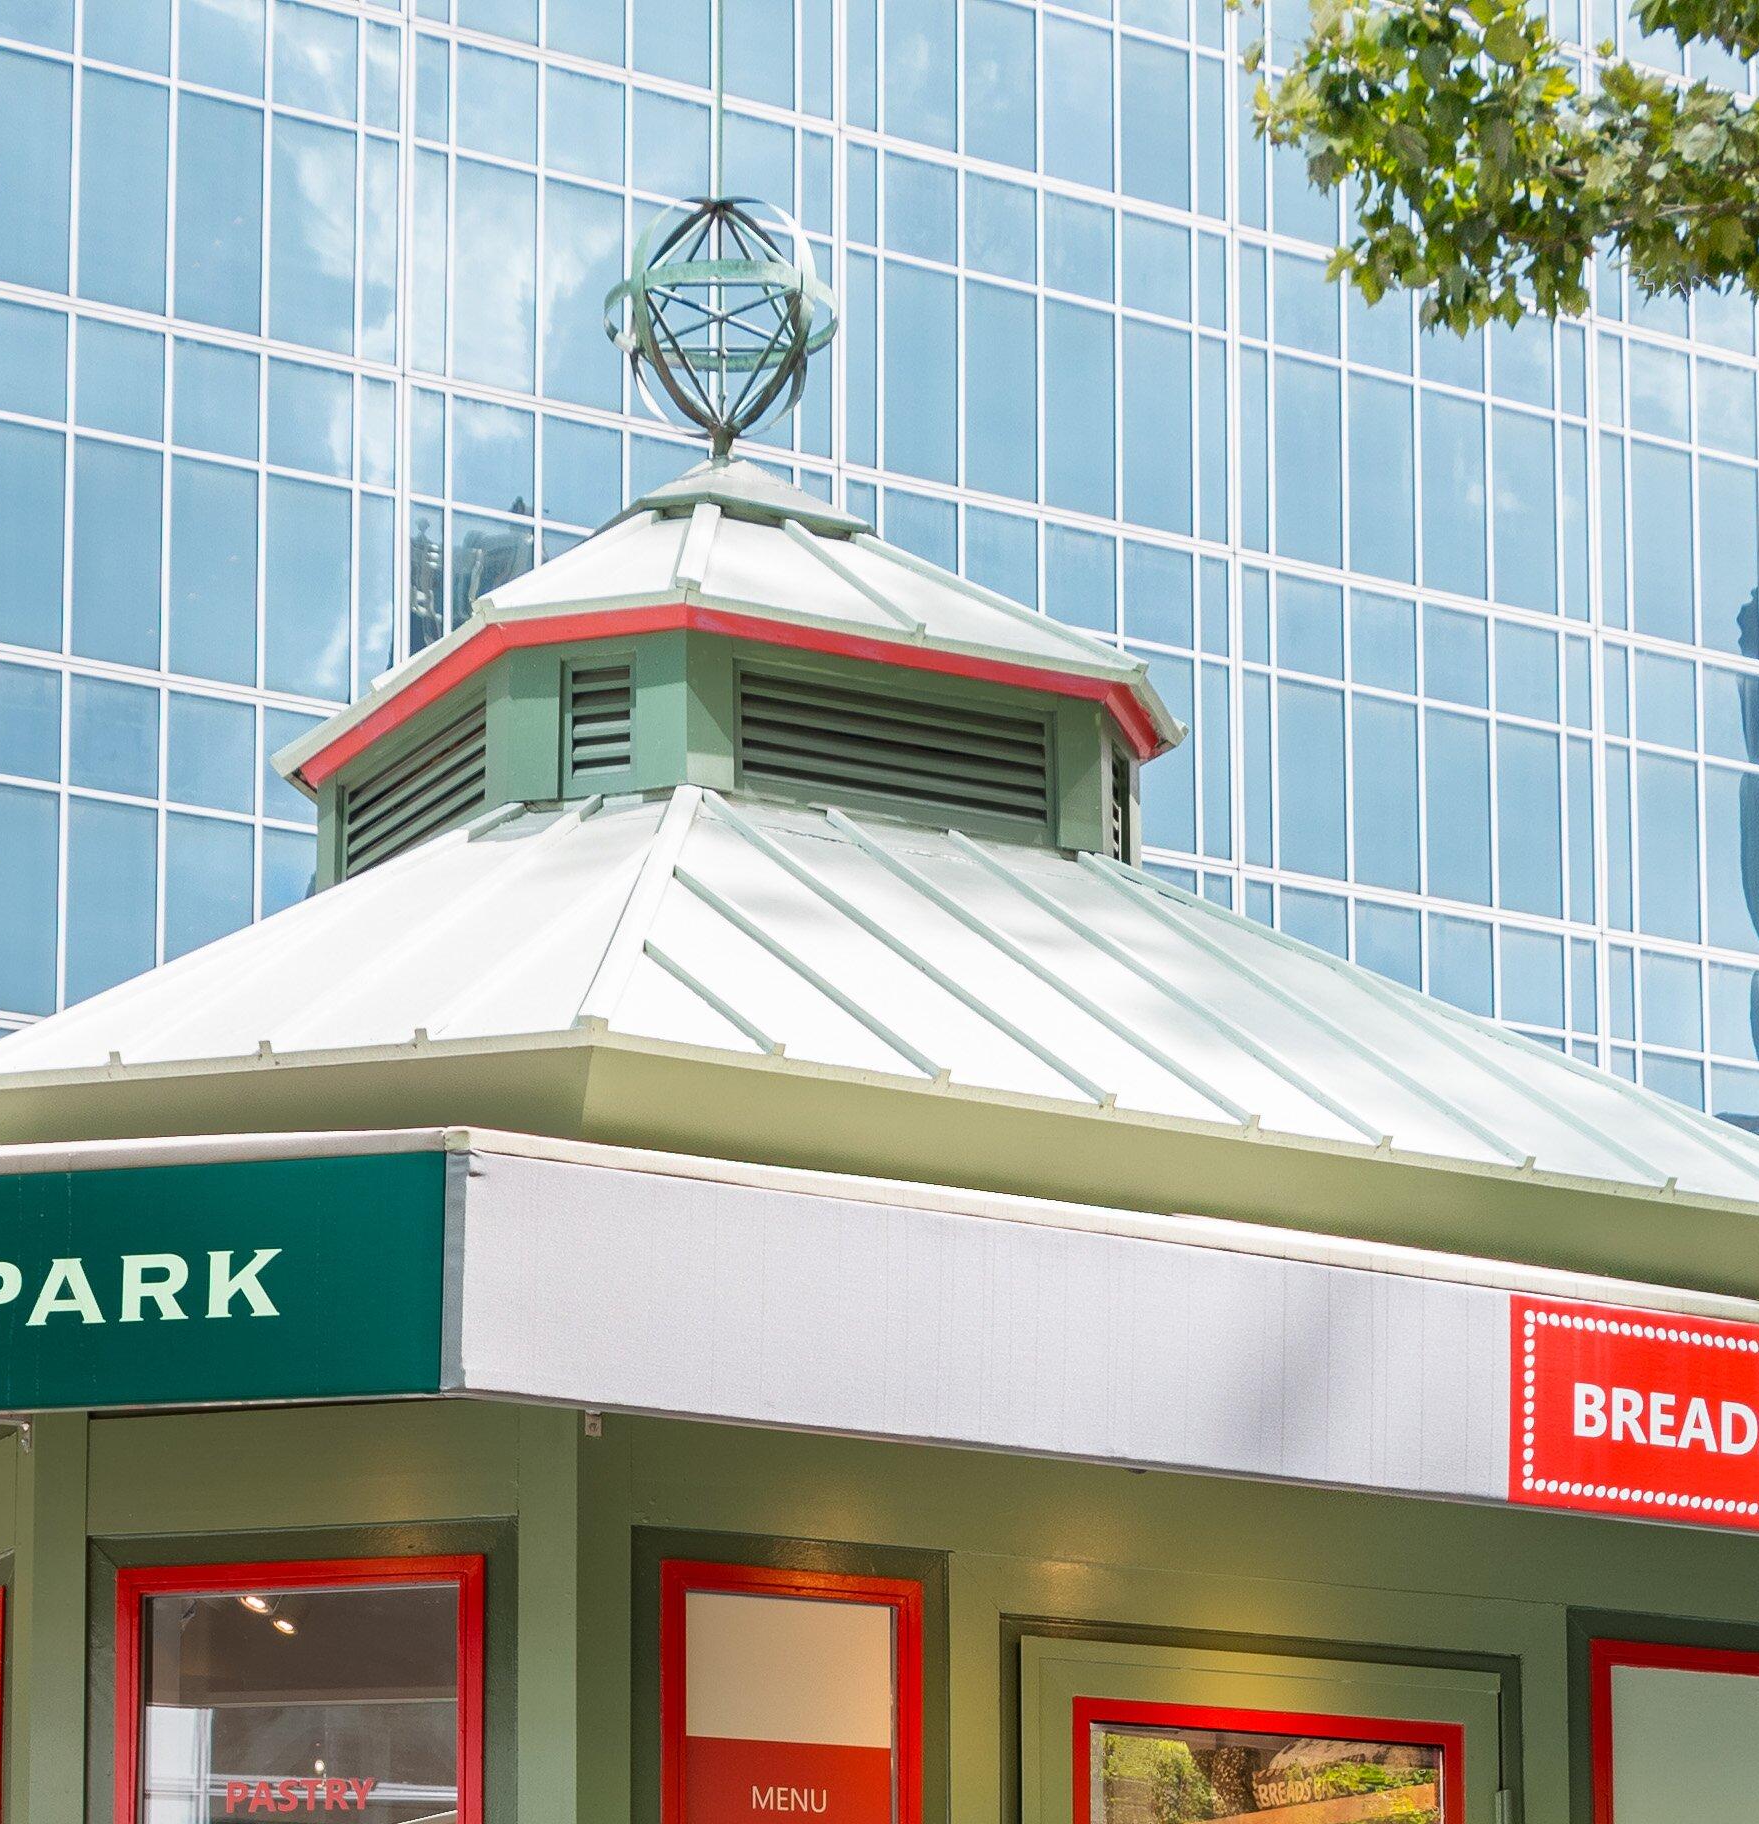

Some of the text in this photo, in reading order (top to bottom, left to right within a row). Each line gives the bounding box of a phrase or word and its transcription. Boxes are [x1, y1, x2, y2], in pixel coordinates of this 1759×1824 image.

[225, 1776, 375, 1814] PASTRY
[751, 1785, 828, 1813] MENU
[1258, 1777, 1313, 1809] BREADS
